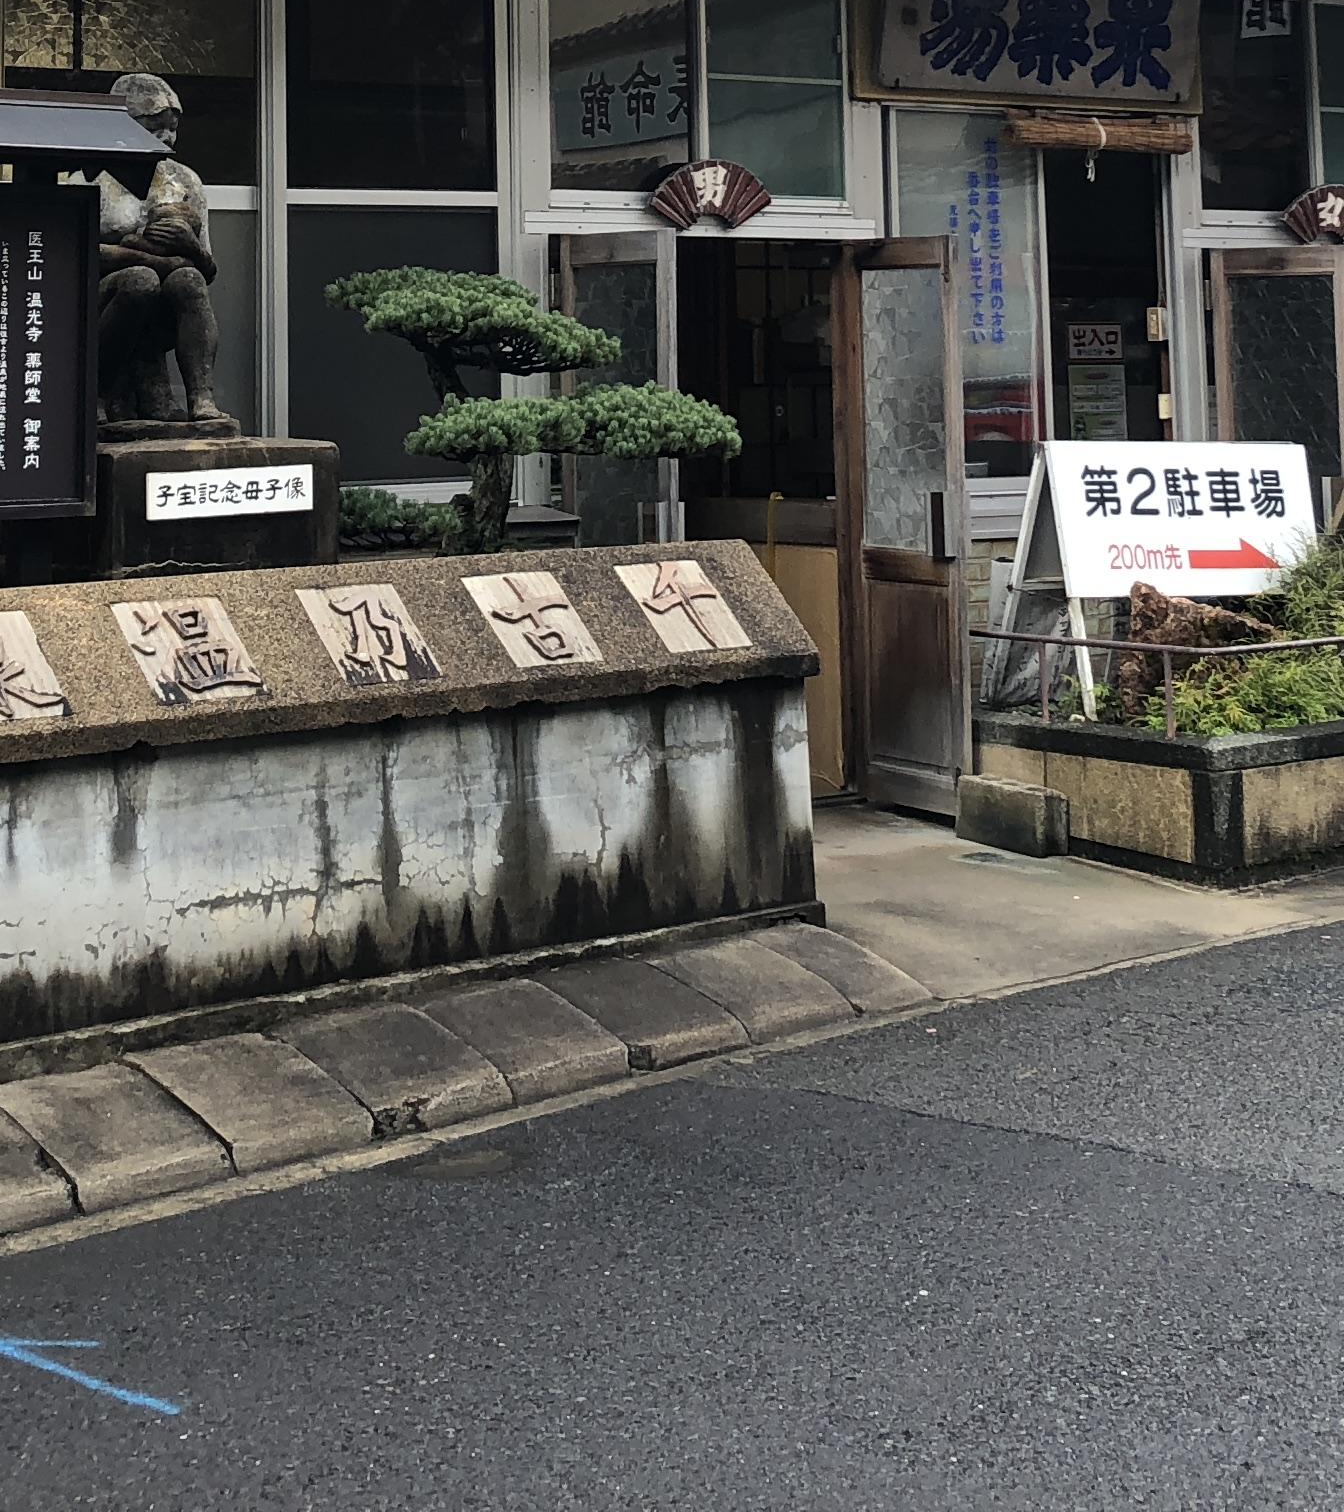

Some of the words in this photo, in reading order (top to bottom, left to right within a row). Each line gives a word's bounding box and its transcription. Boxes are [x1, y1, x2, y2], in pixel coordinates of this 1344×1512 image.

[27, 230, 44, 282] 医王山
[25, 291, 45, 344] 温光寺
[1071, 328, 1119, 347] 出入口
[24, 351, 42, 404] 薬師堂
[23, 417, 41, 470] 御案内
[155, 478, 306, 508] 子宝記念母子像
[1080, 464, 1286, 519] 第2駐車場
[1109, 543, 1183, 571] 200m先
